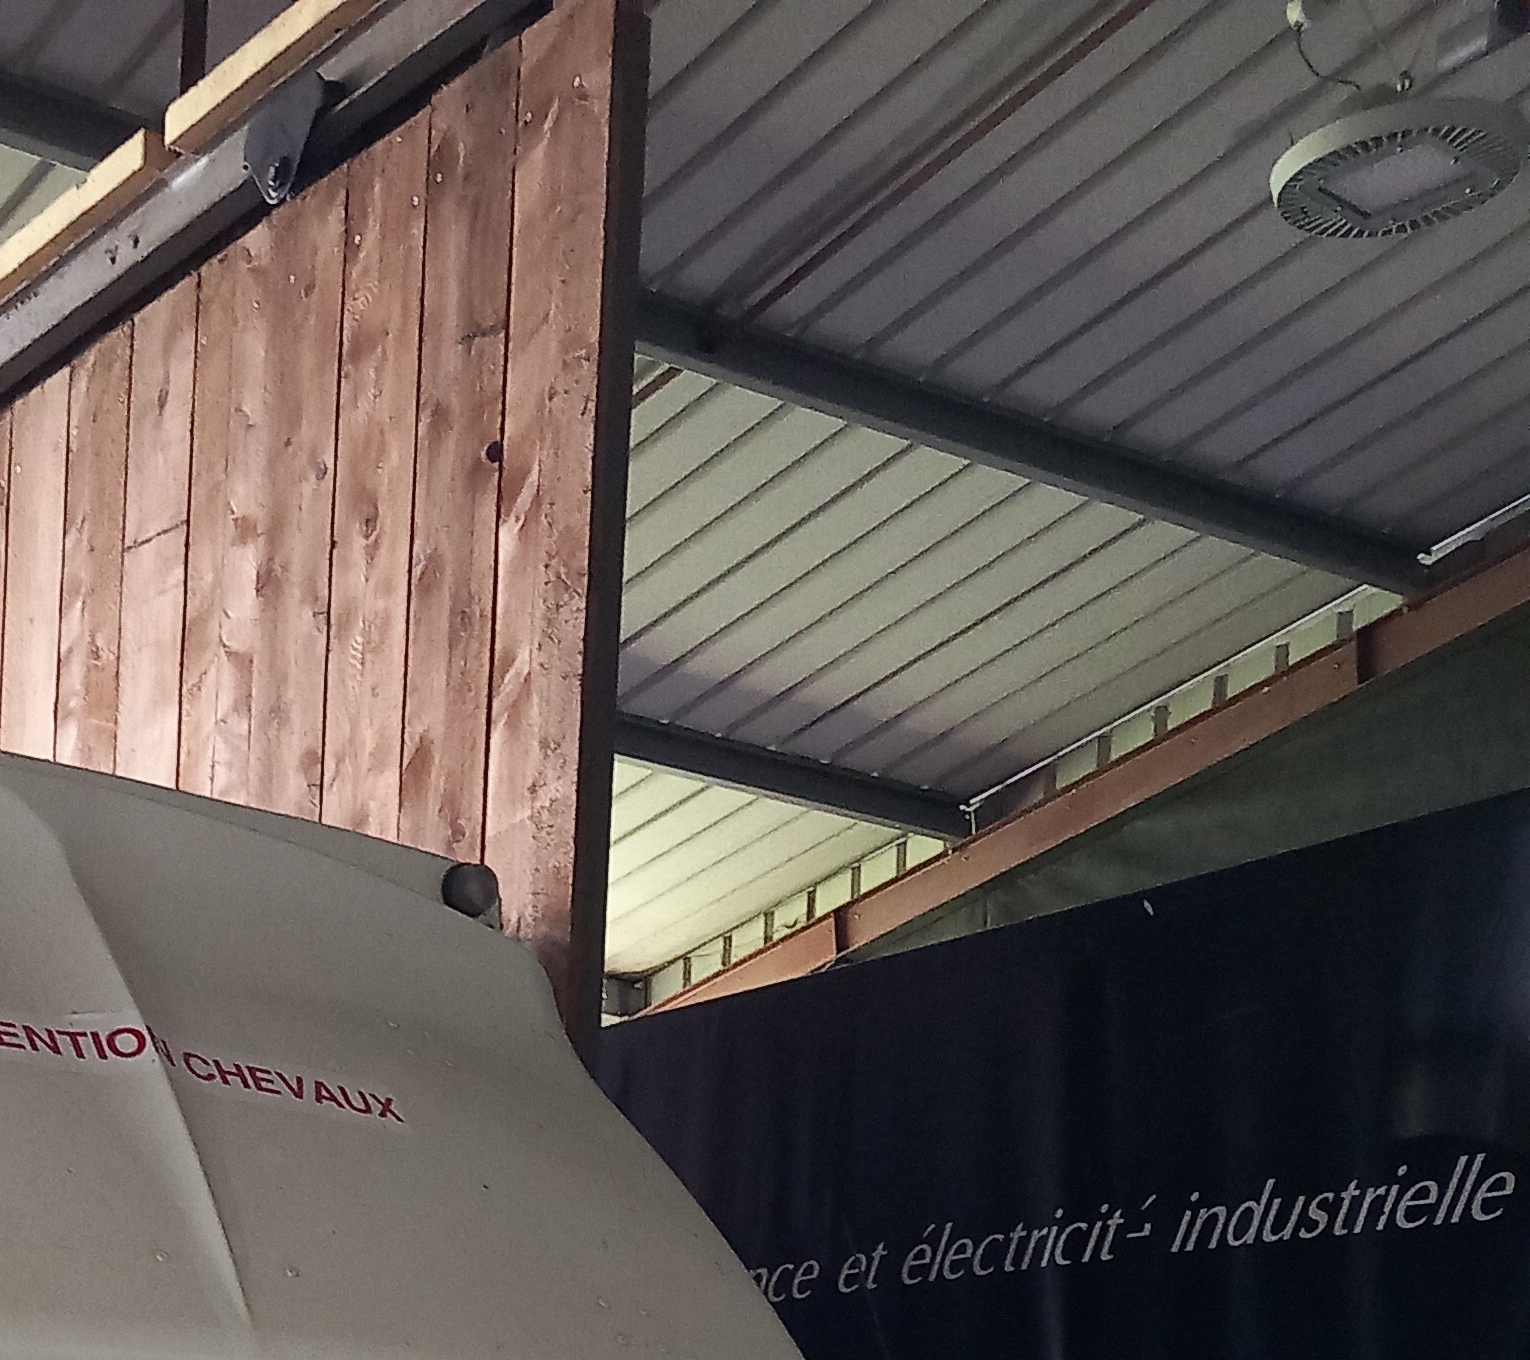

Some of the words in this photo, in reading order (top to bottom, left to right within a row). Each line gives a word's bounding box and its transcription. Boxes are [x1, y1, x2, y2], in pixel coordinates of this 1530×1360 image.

[181, 1051, 405, 1123] CHEVAUX
[837, 1241, 888, 1294] et
[1169, 1152, 1516, 1253] industrielle
